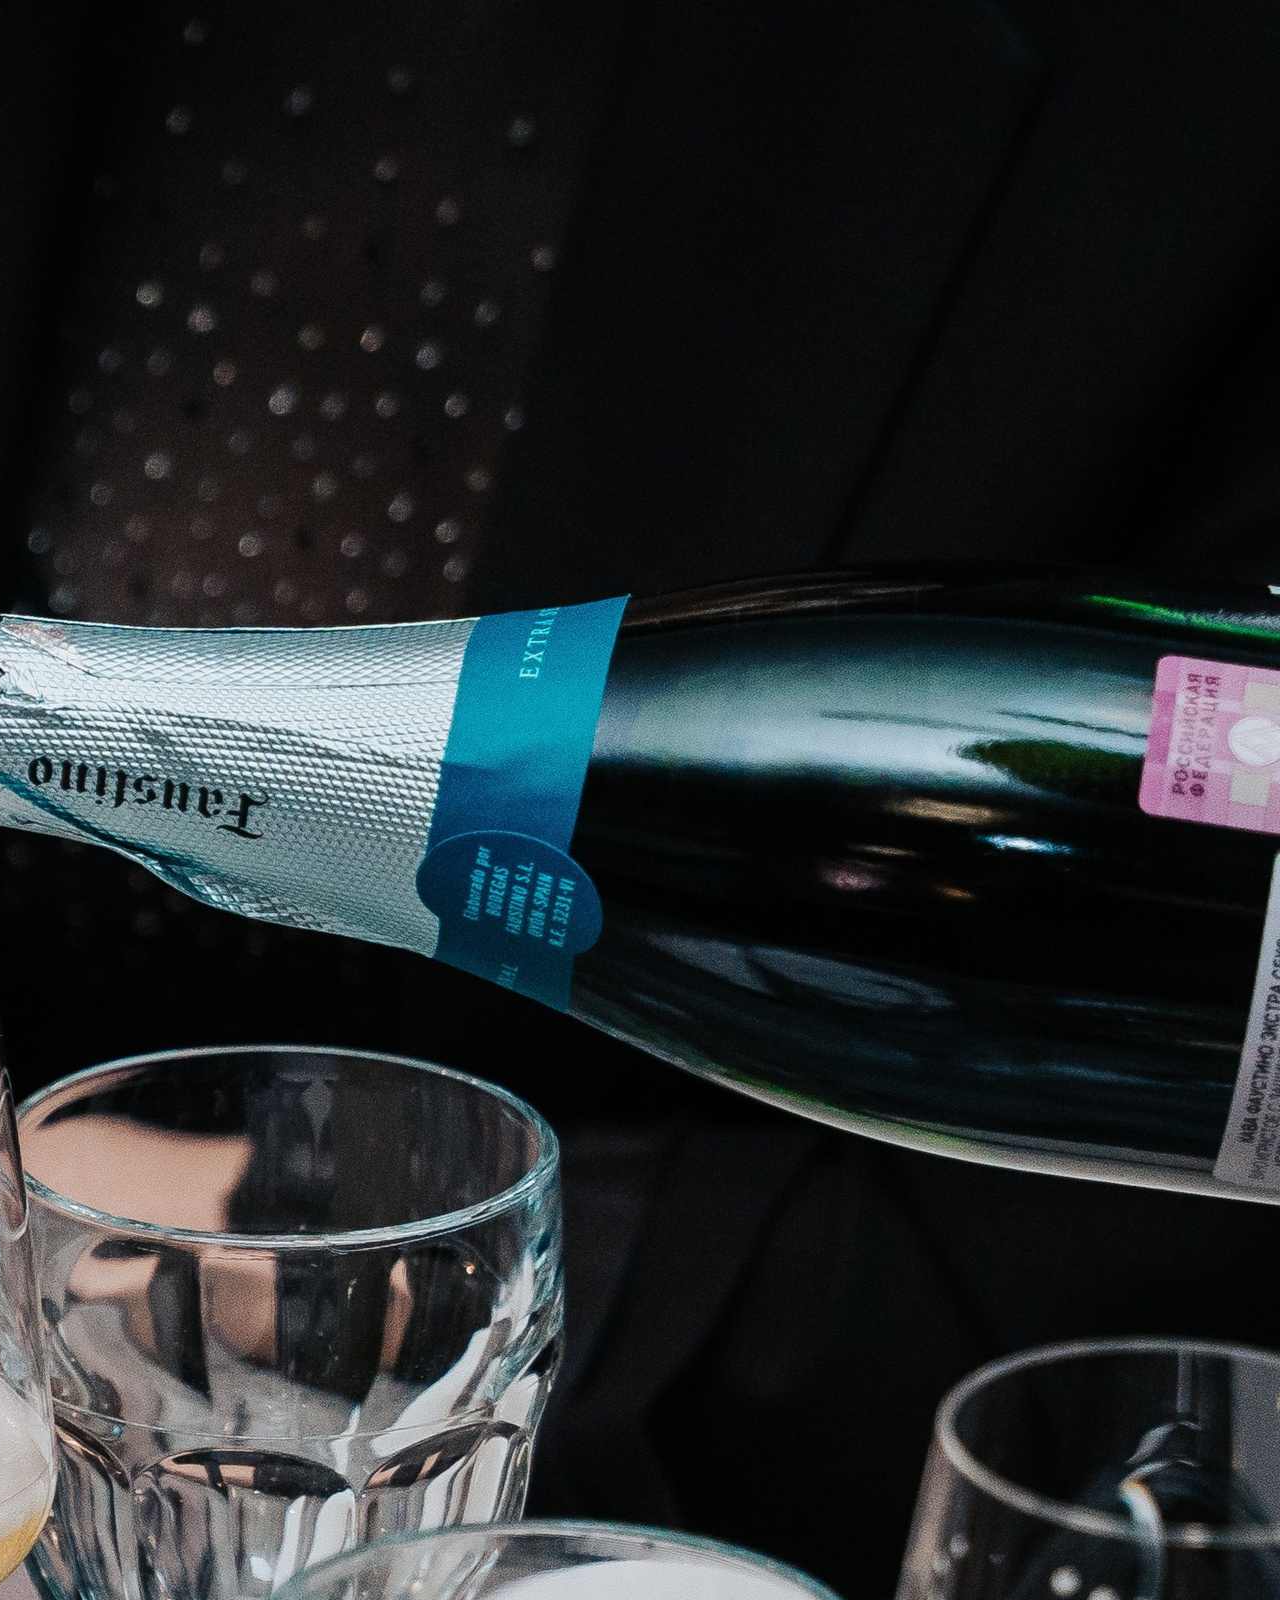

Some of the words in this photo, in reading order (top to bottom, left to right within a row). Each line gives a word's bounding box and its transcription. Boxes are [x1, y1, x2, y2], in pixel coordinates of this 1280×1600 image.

[1188, 675, 1222, 798] ФЕДЕРАЦИЯ
[27, 755, 270, 840] Faustino
[462, 868, 486, 921] Elaborado
[475, 845, 492, 868] por
[485, 865, 509, 917] BODEGAS
[505, 885, 528, 936] FAUSTINO
[1246, 1044, 1275, 1115] ФАУСТИНО
